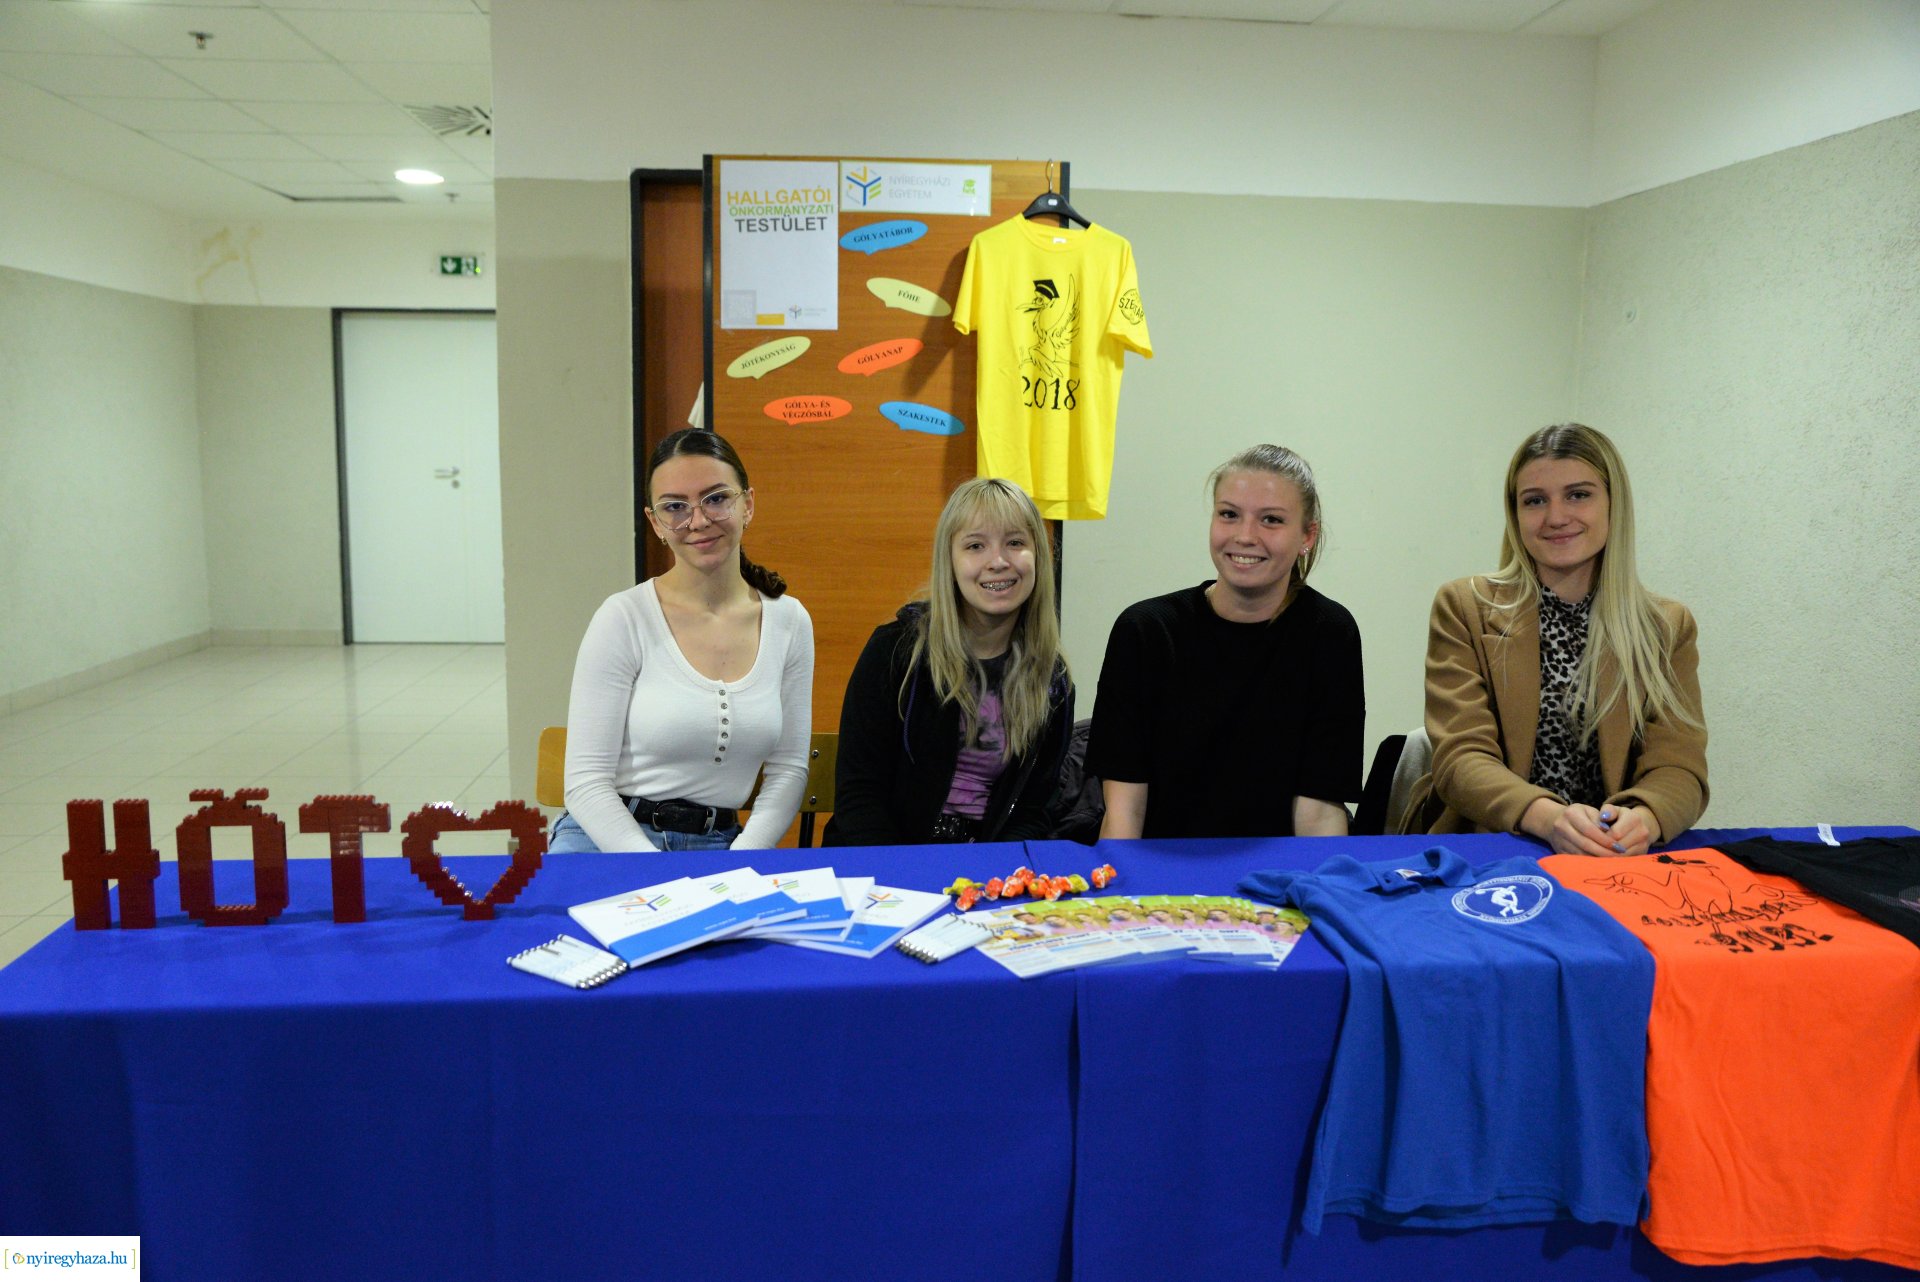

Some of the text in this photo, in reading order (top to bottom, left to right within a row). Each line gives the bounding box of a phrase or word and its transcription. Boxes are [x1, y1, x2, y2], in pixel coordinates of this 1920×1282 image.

[727, 186, 832, 205] HALLGATÓI
[889, 188, 932, 200] EGYETEM
[728, 203, 835, 217] ÖNKORMÁNYZATI
[734, 214, 828, 233] TESTÜLET
[853, 226, 914, 243] GÓLYATÁBOR
[740, 344, 796, 370] JÓTÉKONYSÁG
[857, 346, 904, 366] GÓLYANAP
[1021, 375, 1081, 411] 2018
[898, 408, 947, 427] SZAKESTEK
